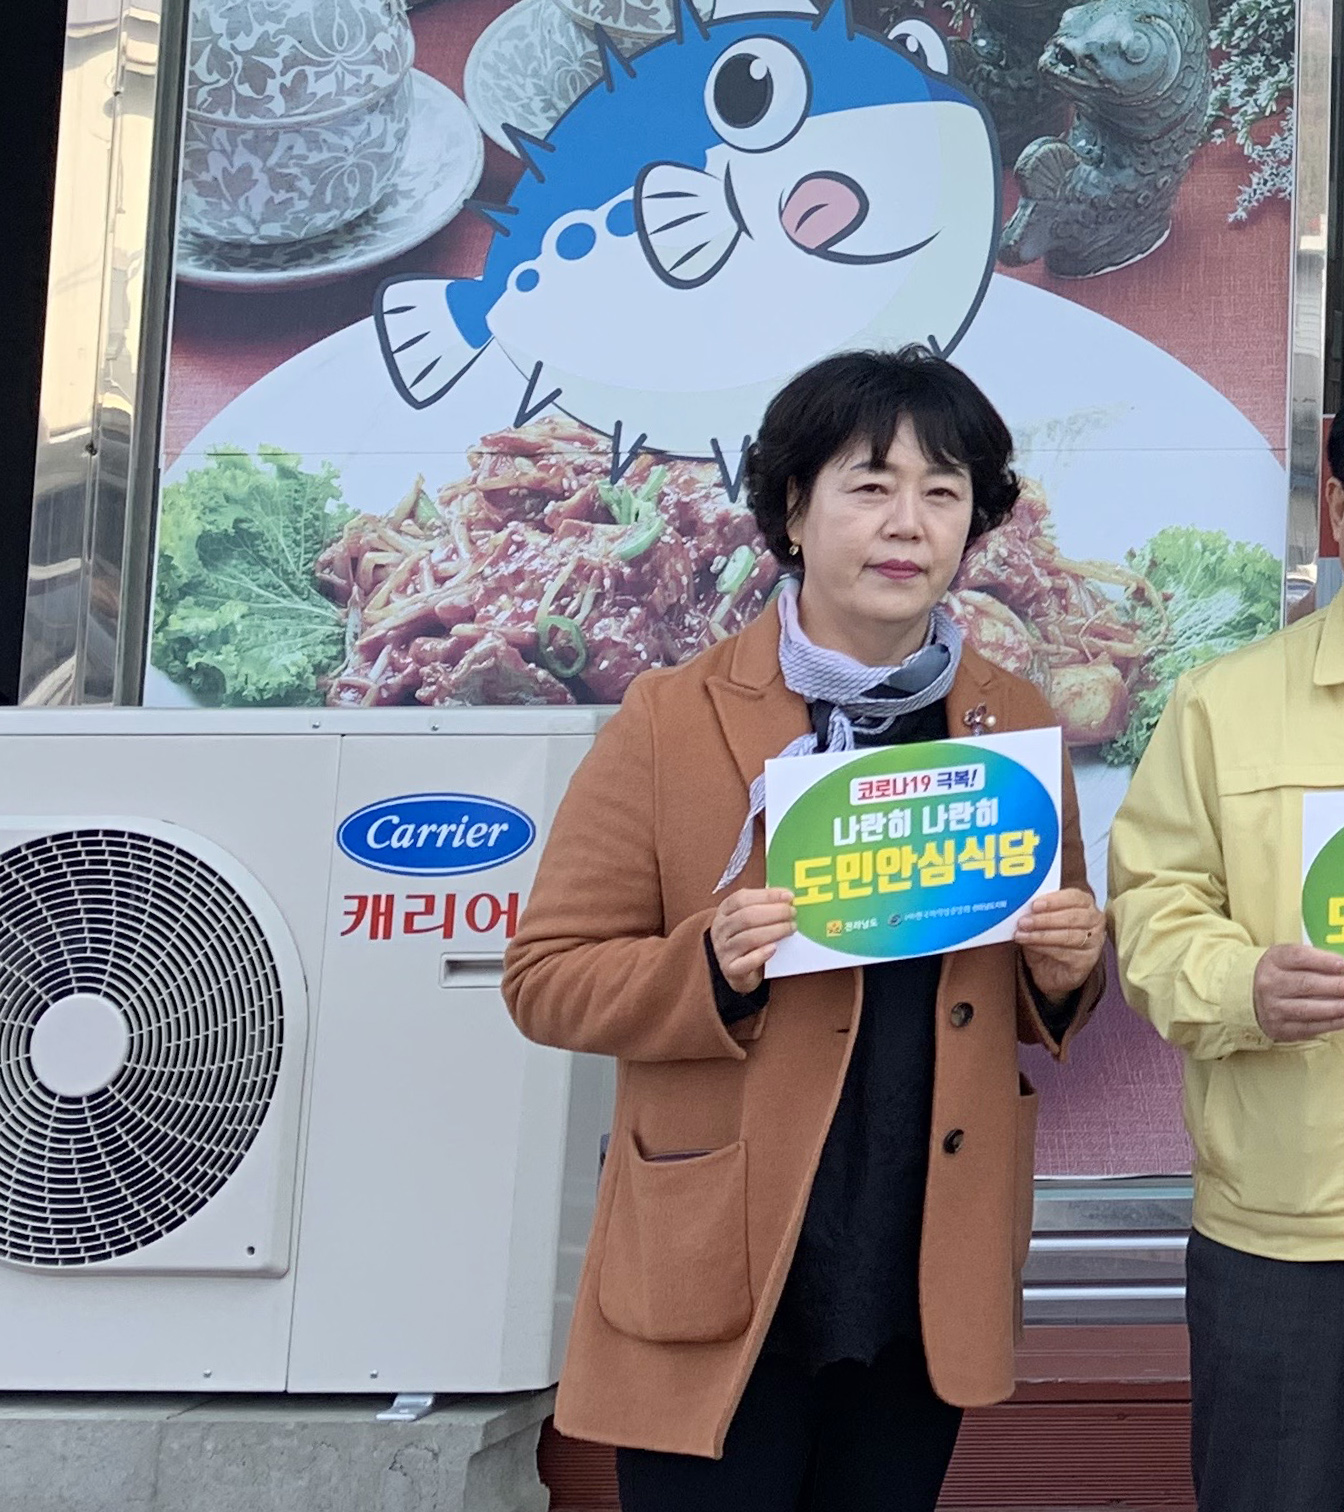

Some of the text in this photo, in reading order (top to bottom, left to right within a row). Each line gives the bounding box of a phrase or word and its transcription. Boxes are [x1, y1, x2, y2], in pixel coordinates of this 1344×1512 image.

[857, 768, 977, 801] 코로나19 극복!
[366, 814, 509, 849] Carrier
[833, 796, 999, 847] 나란히 나란히
[792, 828, 1041, 906] 도민안심식당
[340, 892, 519, 940] 캐리어
